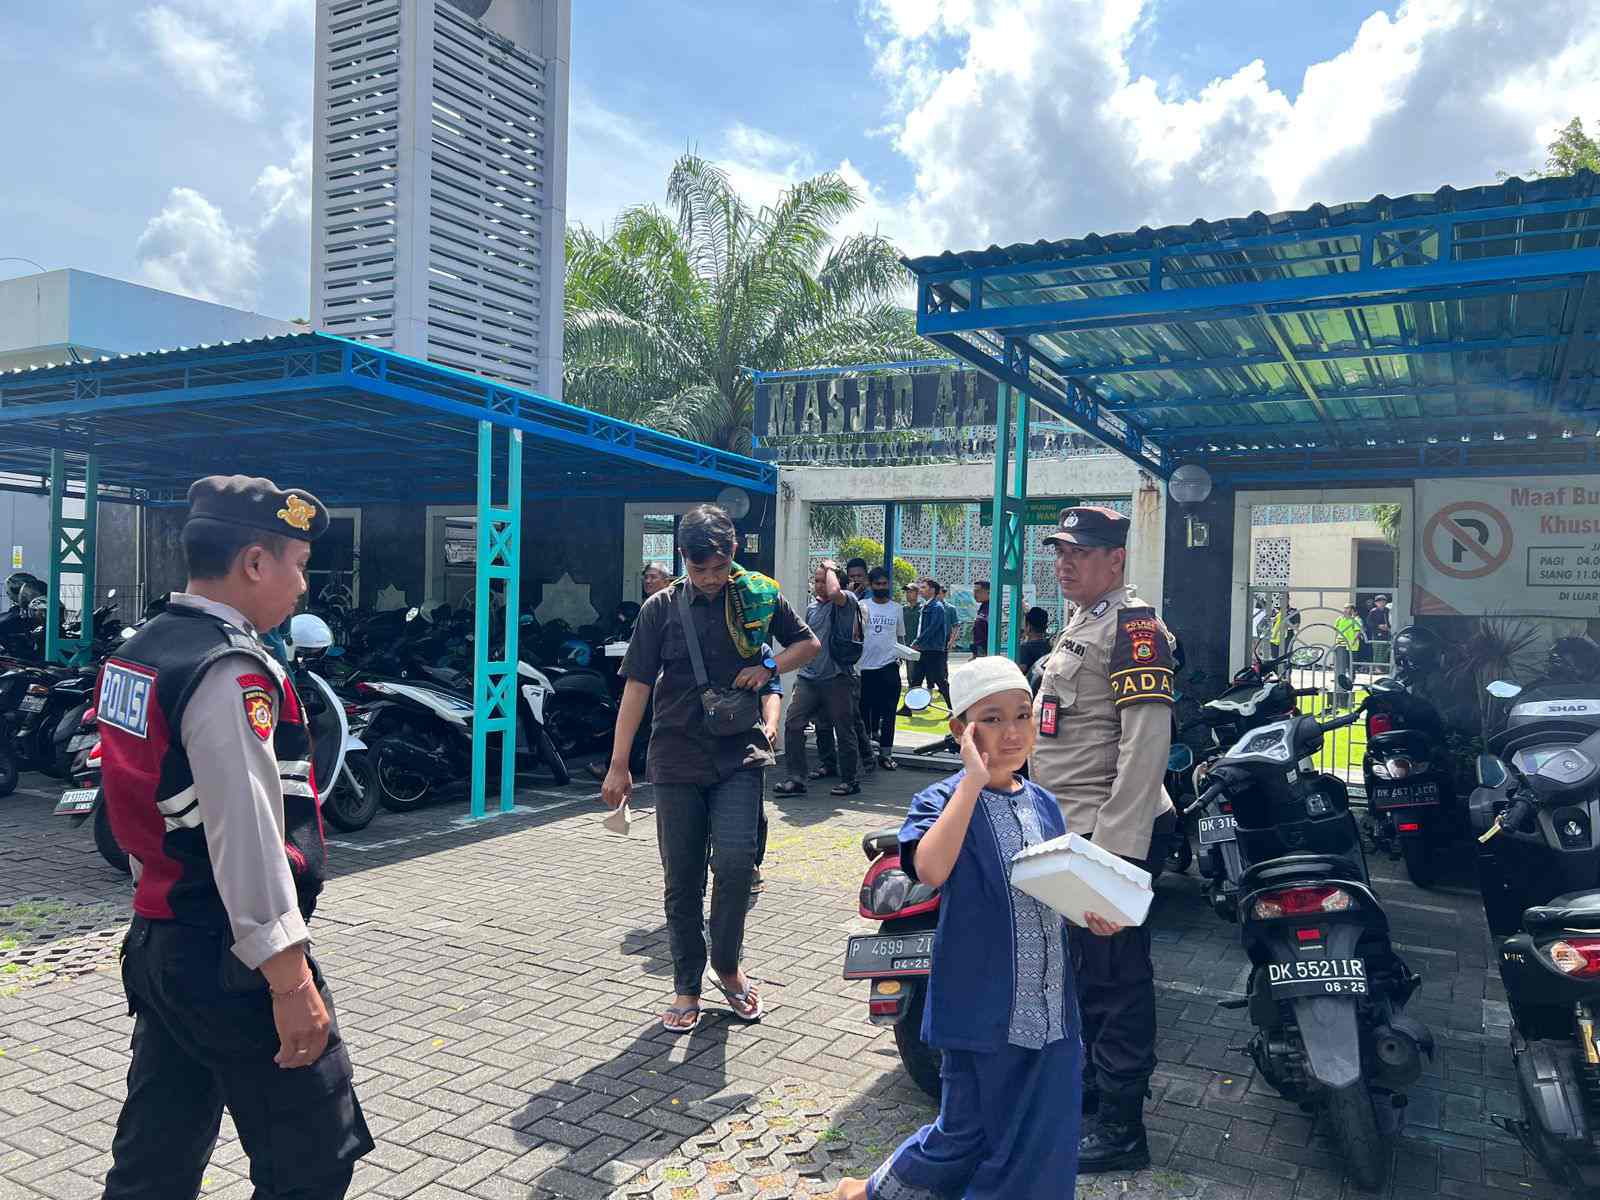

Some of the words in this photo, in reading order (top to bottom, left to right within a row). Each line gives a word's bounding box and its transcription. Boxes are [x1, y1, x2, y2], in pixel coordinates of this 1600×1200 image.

[767, 374, 914, 436] MASJID
[777, 443, 867, 461] BANDARA
[1510, 487, 1567, 506] Maaf
[1540, 557, 1565, 566] PAGI
[1540, 570, 1573, 580] SIANG
[1559, 592, 1570, 600] DI
[1573, 592, 1599, 601] LUAR
[1061, 640, 1086, 657] POLRI
[102, 670, 151, 733] POLISI
[1201, 820, 1215, 831] DK
[851, 943, 860, 958] P
[1268, 962, 1293, 981] DK
